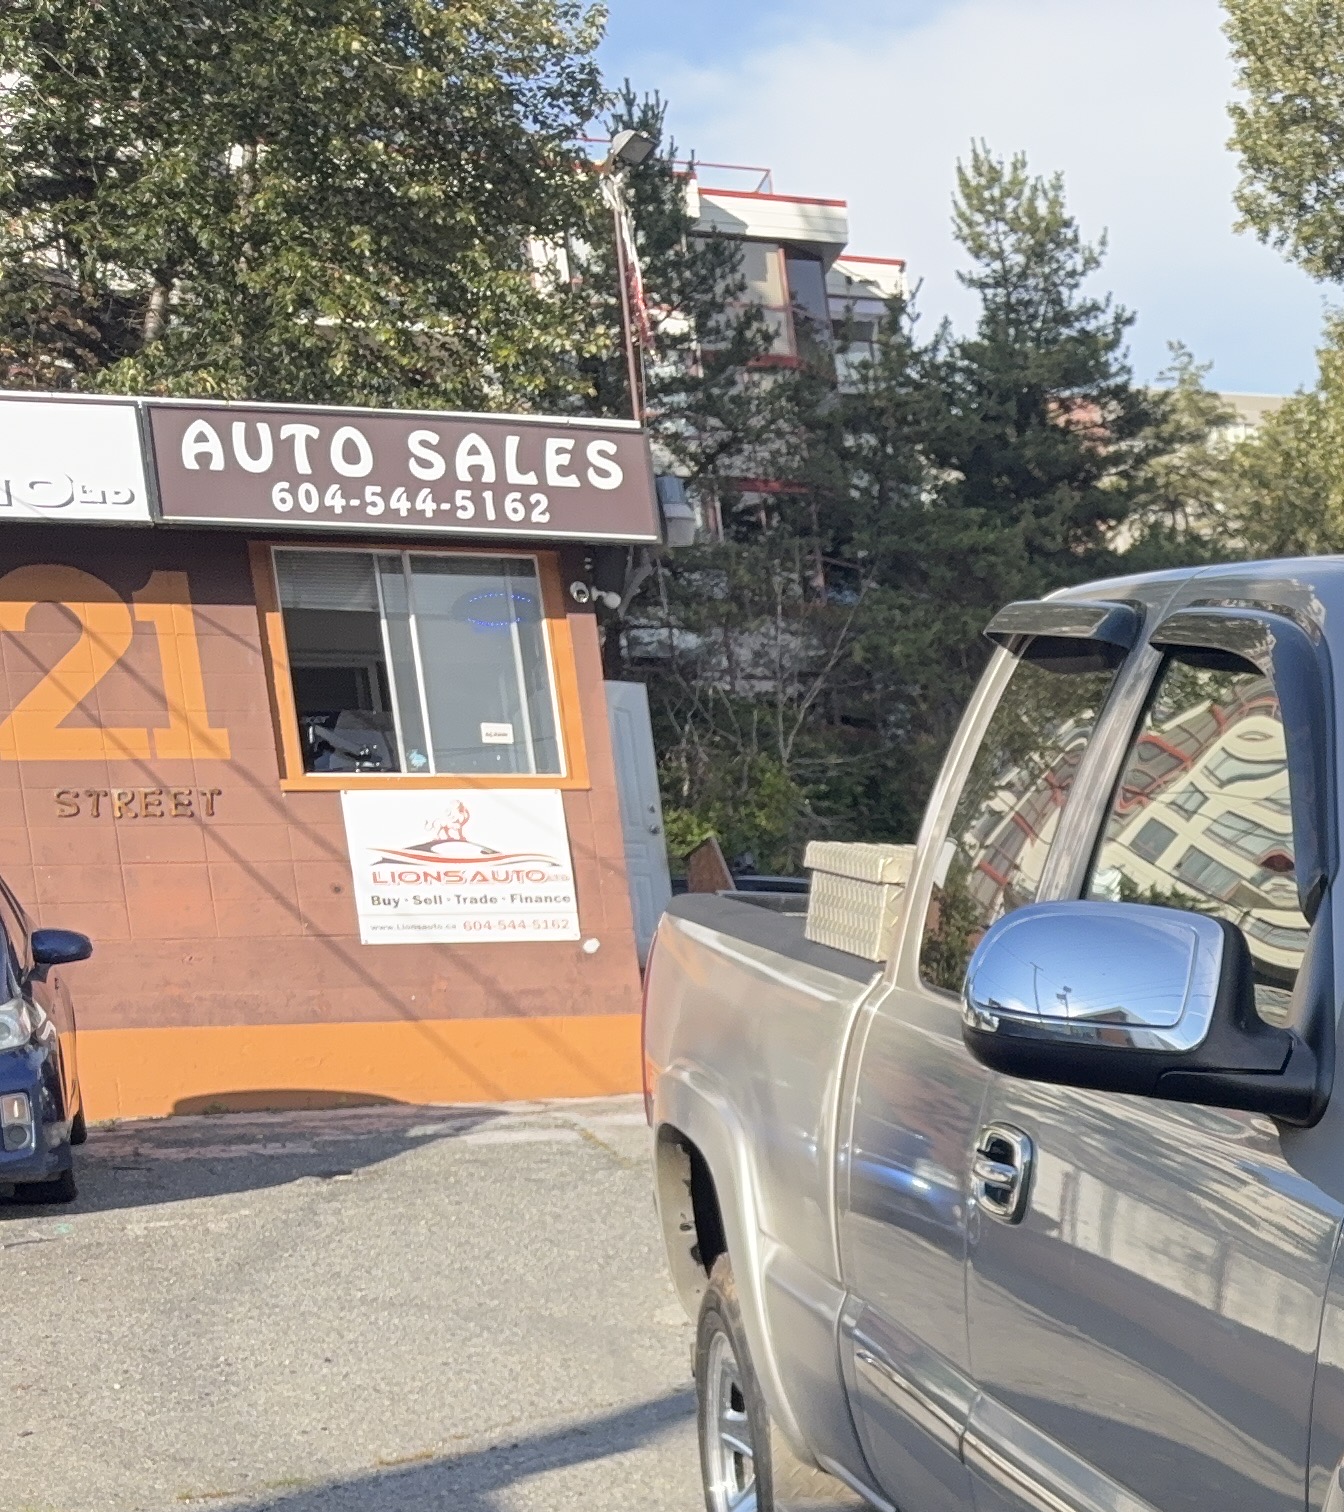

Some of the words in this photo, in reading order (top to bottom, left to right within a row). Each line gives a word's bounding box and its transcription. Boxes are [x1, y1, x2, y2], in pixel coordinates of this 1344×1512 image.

[181, 418, 374, 478] AUTO
[407, 429, 624, 490] SALES
[271, 481, 551, 523] 604-544-5162
[0, 563, 231, 761] 21
[54, 788, 222, 819] STREET
[371, 894, 400, 907] Buy
[412, 894, 443, 906] Sell
[454, 894, 498, 905] Trade
[509, 893, 571, 904] Finance
